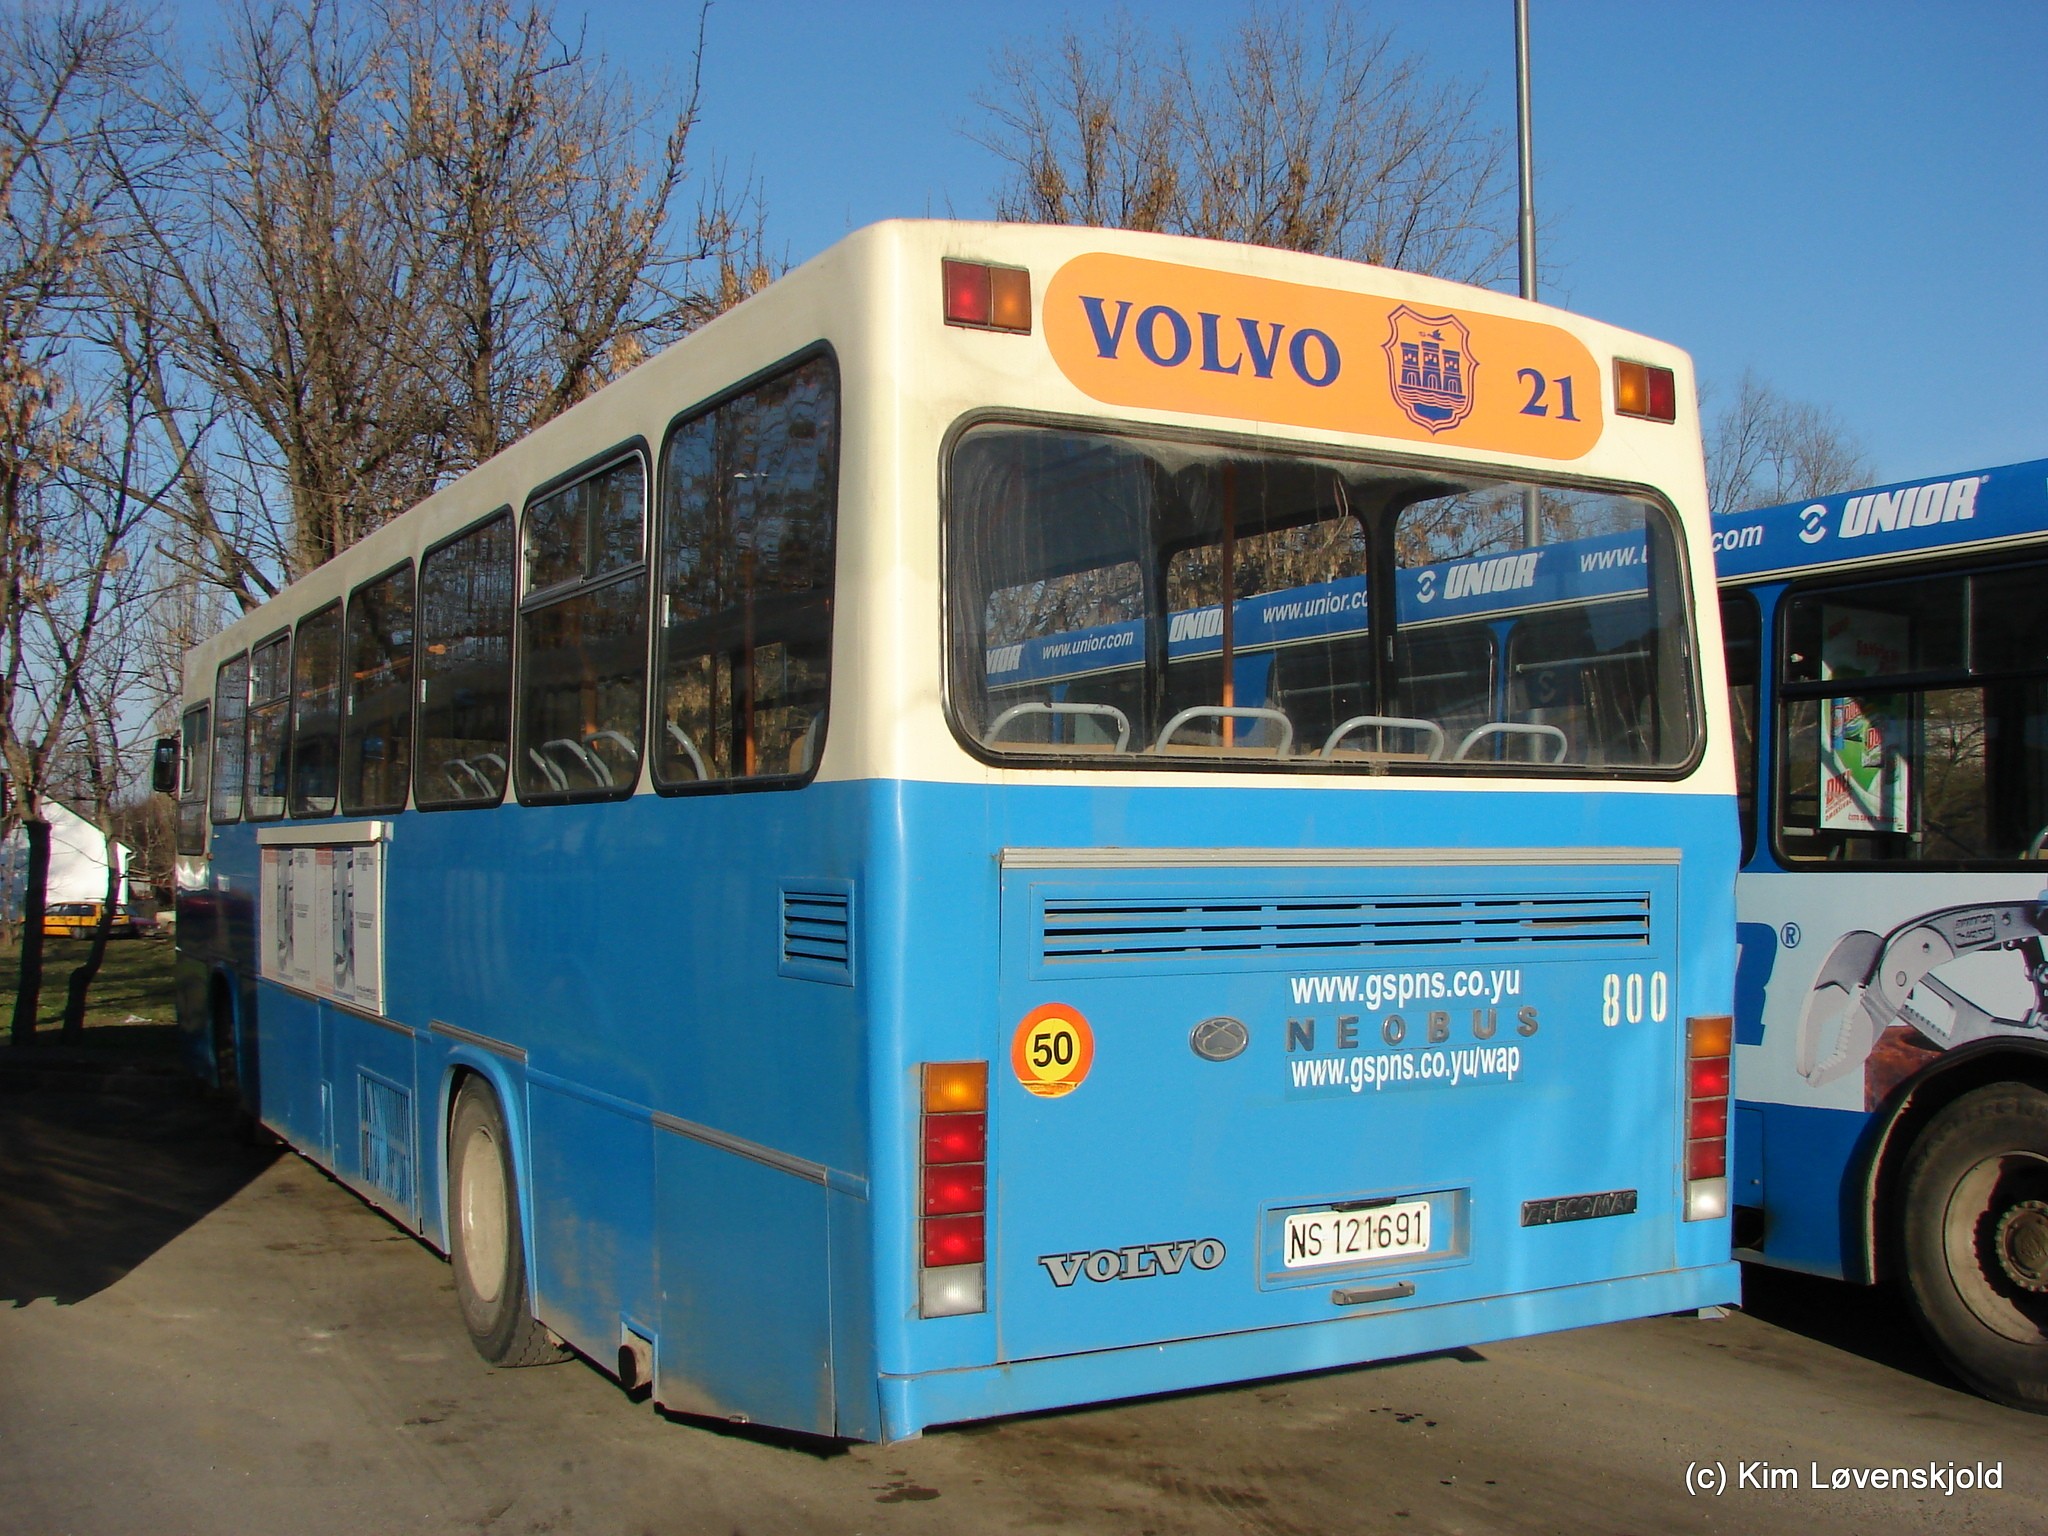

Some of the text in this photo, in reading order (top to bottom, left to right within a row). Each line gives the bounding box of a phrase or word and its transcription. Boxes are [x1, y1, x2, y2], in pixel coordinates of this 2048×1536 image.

[1079, 295, 1581, 423] VOLVO 21
[1042, 631, 1134, 660] www.unior.com
[1168, 608, 1225, 643] UNIO
[1290, 969, 1521, 1010] www.gspns.co.yu
[1602, 971, 1668, 1027] 800
[1033, 1021, 1074, 1068] 50
[1286, 1006, 1540, 1052] NEOBUS
[1291, 1046, 1521, 1093] www.gspns.co.yu/wap
[1039, 1237, 1227, 1287] VOLVO
[1291, 1222, 1323, 1260] NS
